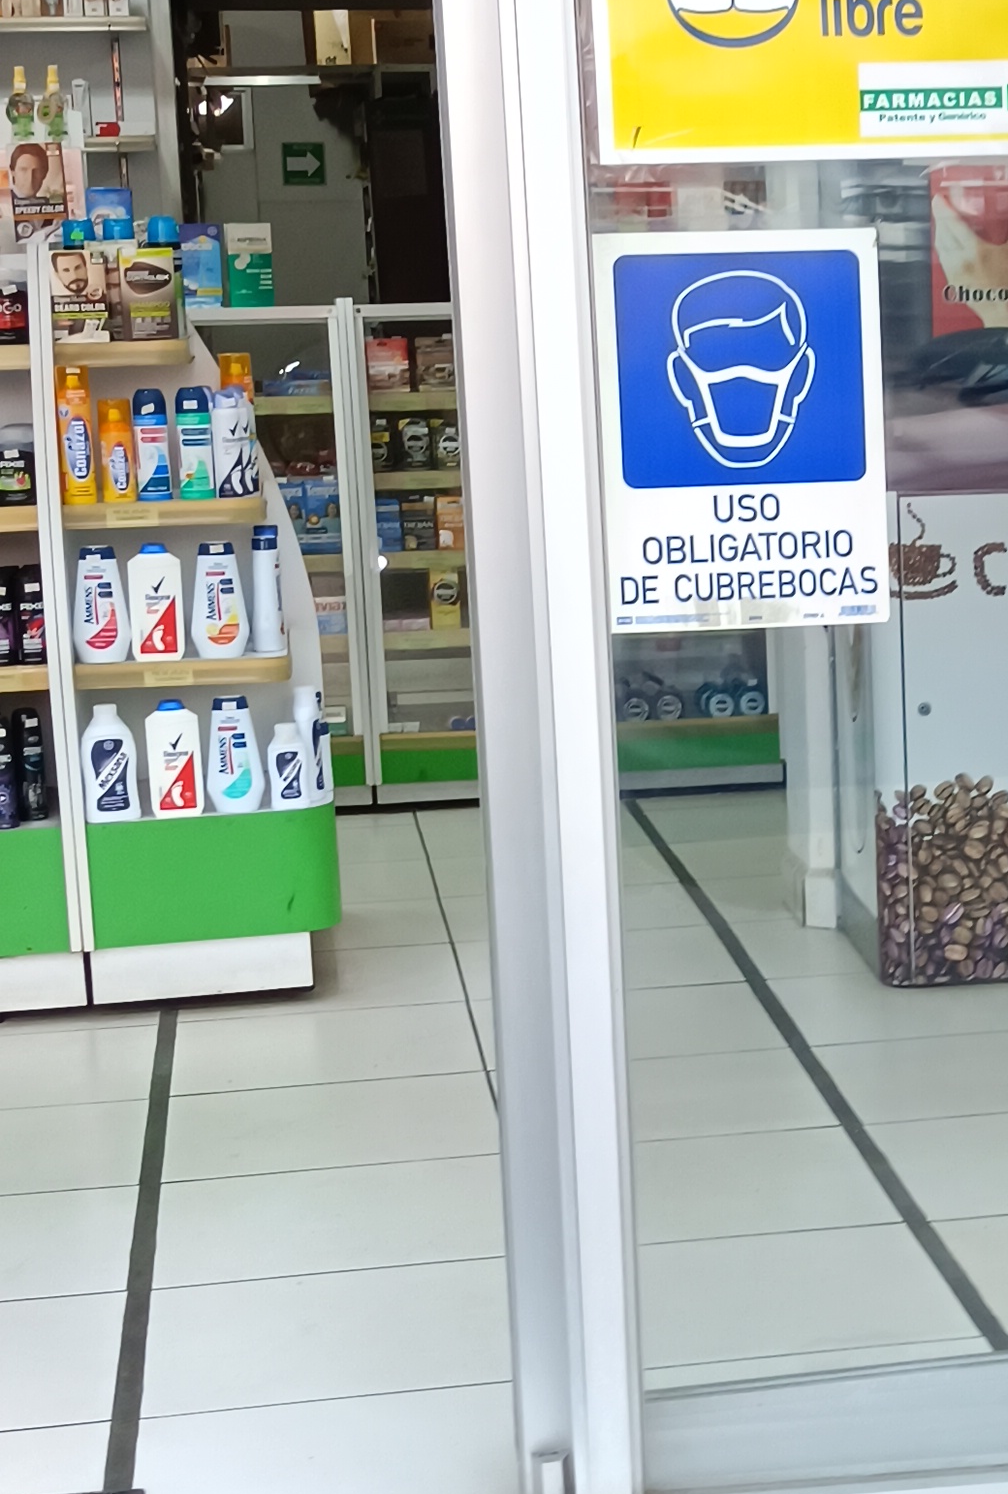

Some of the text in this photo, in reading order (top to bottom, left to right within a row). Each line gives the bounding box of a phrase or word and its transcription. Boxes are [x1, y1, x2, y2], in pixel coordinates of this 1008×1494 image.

[862, 90, 998, 110] FARMACIAS
[878, 113, 926, 123] Patente
[929, 114, 936, 123] y
[712, 493, 781, 524] USO
[642, 529, 854, 566] OBLIGATORIO
[621, 566, 879, 606] DE CUBREBOCAS
